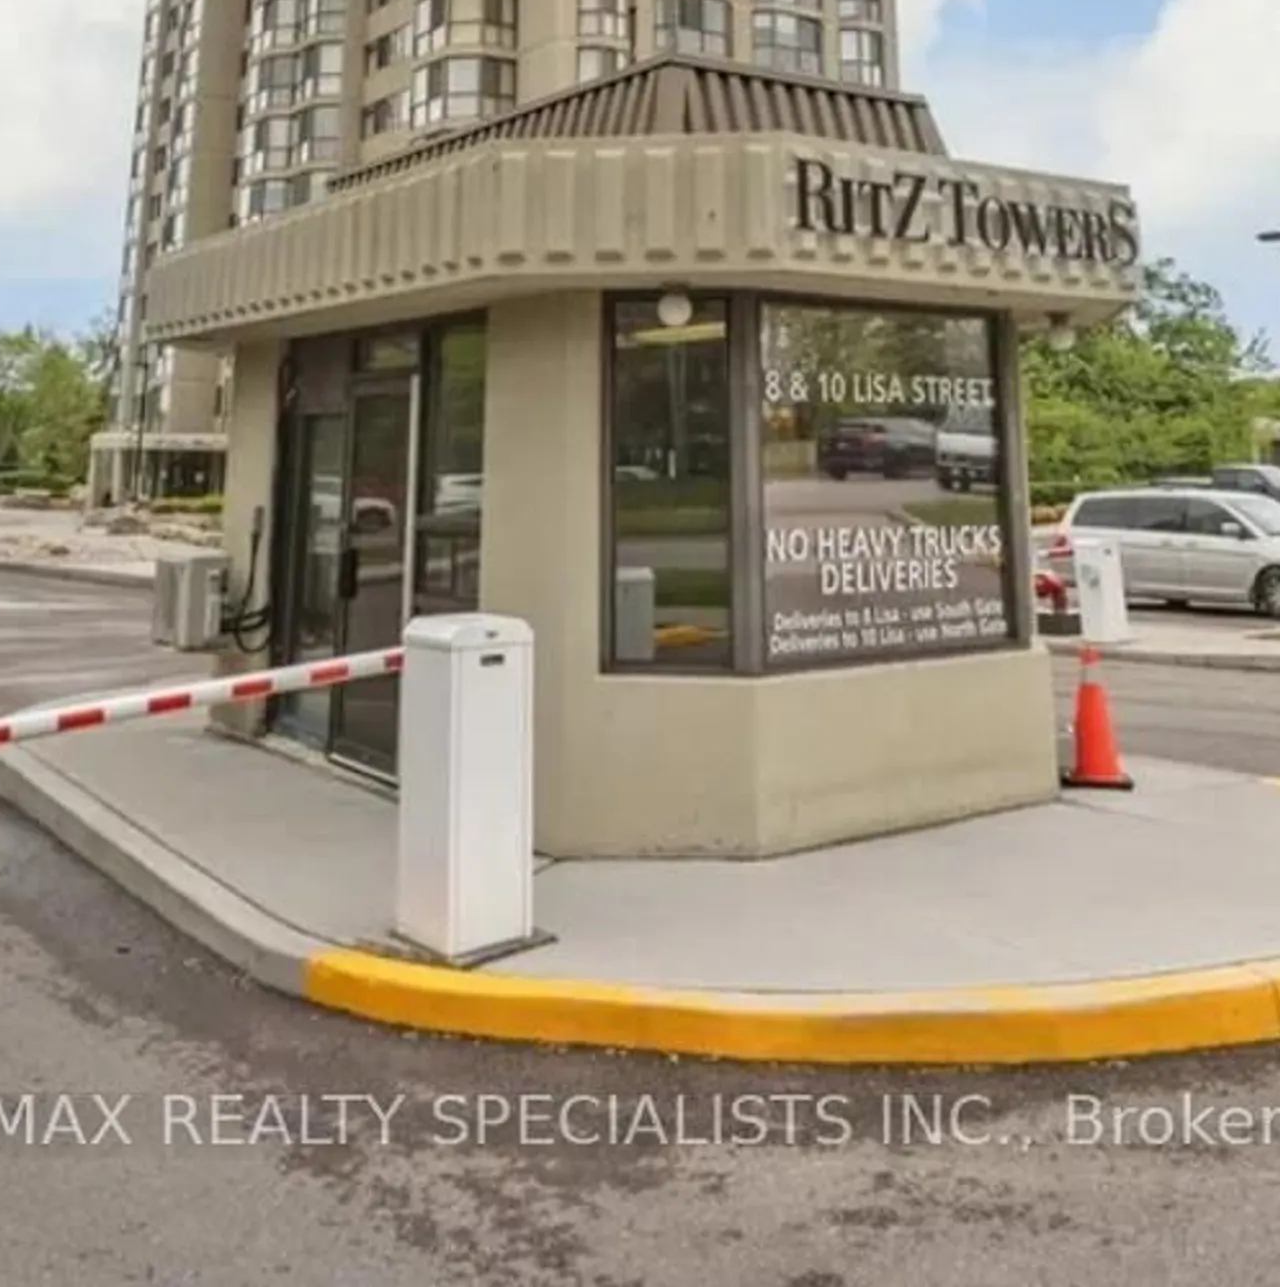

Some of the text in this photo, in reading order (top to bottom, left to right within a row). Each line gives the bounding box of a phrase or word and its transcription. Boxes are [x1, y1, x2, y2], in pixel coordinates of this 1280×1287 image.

[938, 176, 1140, 267] TOWERS
[765, 369, 995, 407] 8 & 10 LISA STREET
[767, 524, 1002, 561] NO HEAVY TRUCKS
[821, 559, 958, 596] DELIVERIES
[774, 608, 842, 631] Deliveries
[770, 631, 840, 653] Deliveries
